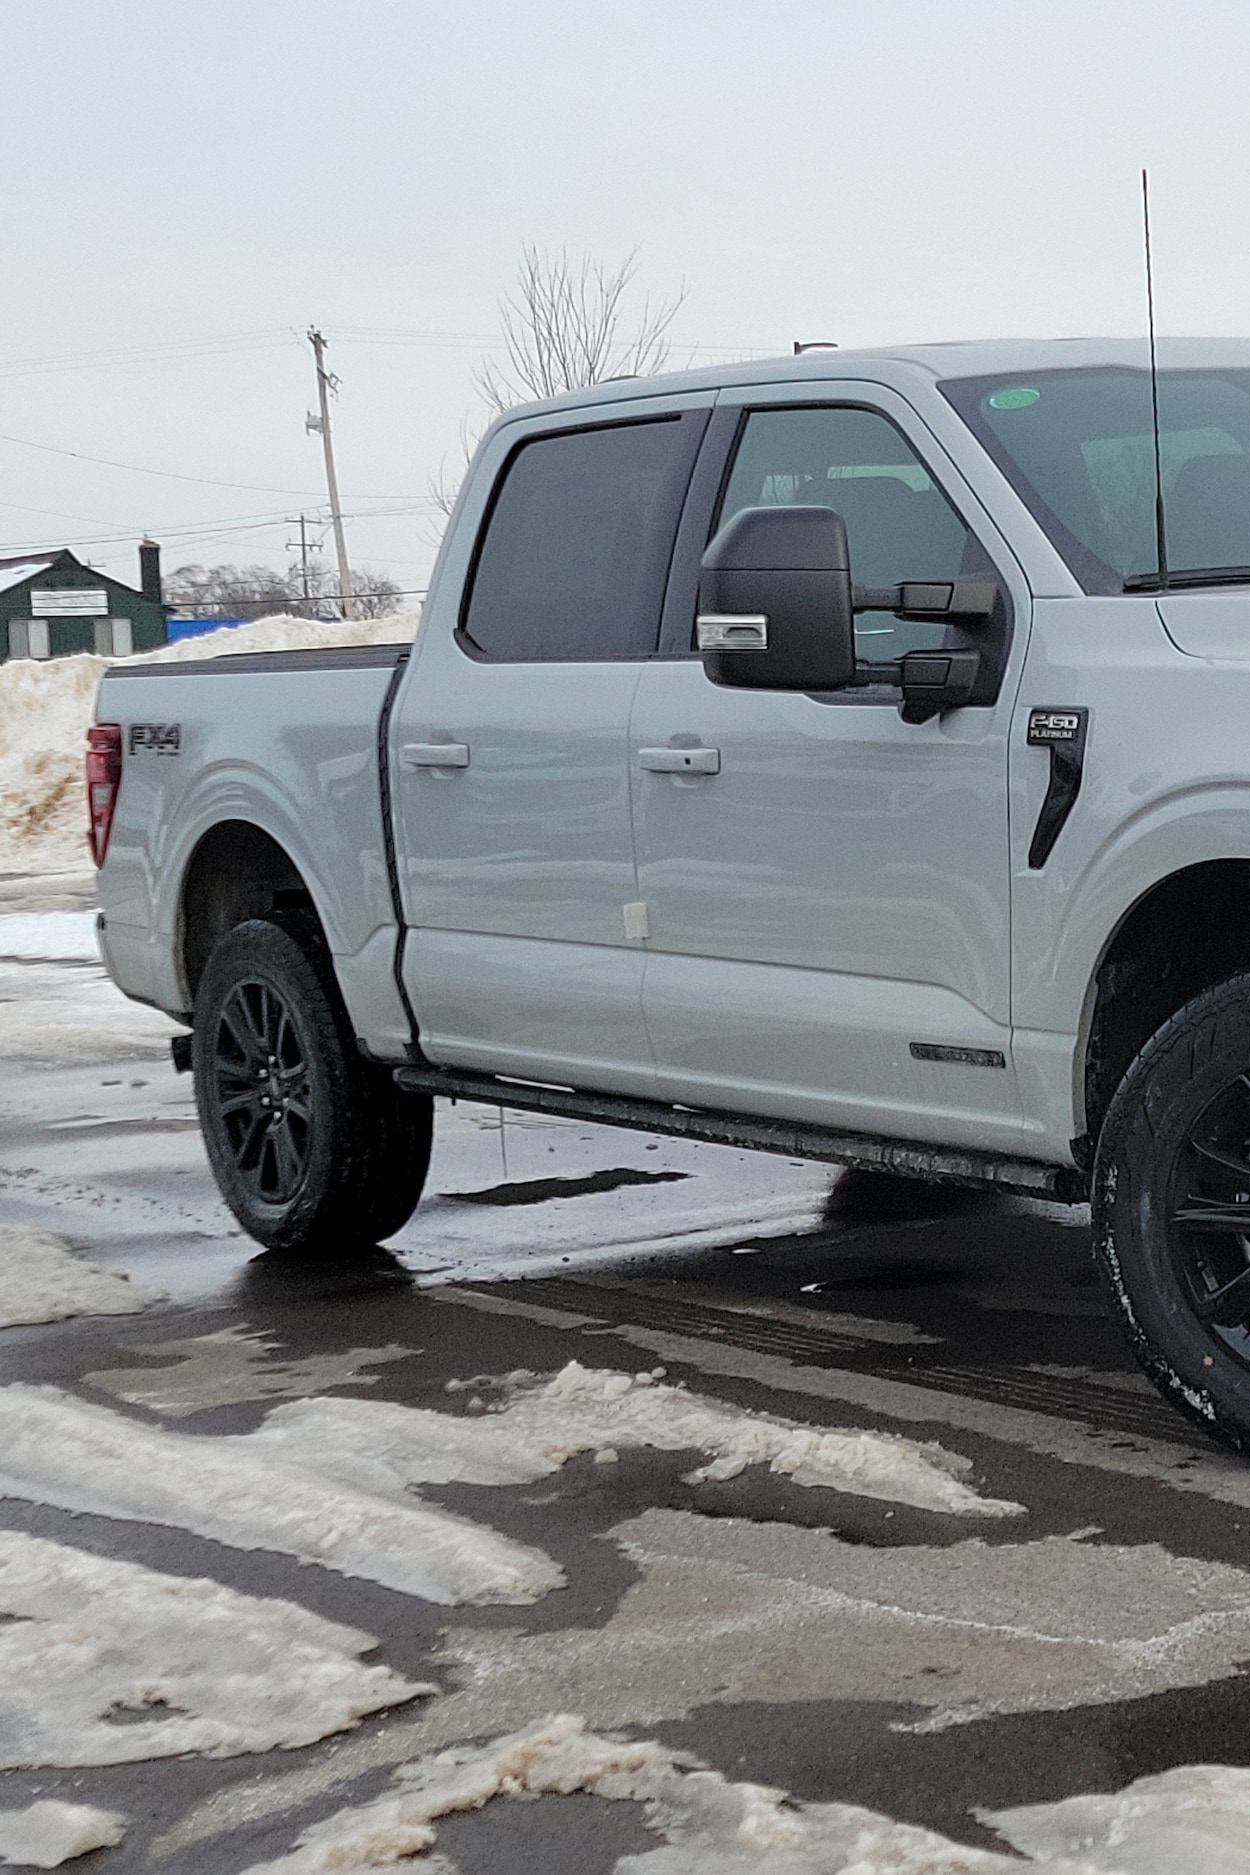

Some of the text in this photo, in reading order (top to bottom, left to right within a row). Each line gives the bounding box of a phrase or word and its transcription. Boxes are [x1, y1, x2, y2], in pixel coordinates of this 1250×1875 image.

[1030, 714, 1079, 730] F-150
[129, 722, 181, 756] FX4
[1030, 729, 1073, 739] PLATINUM
